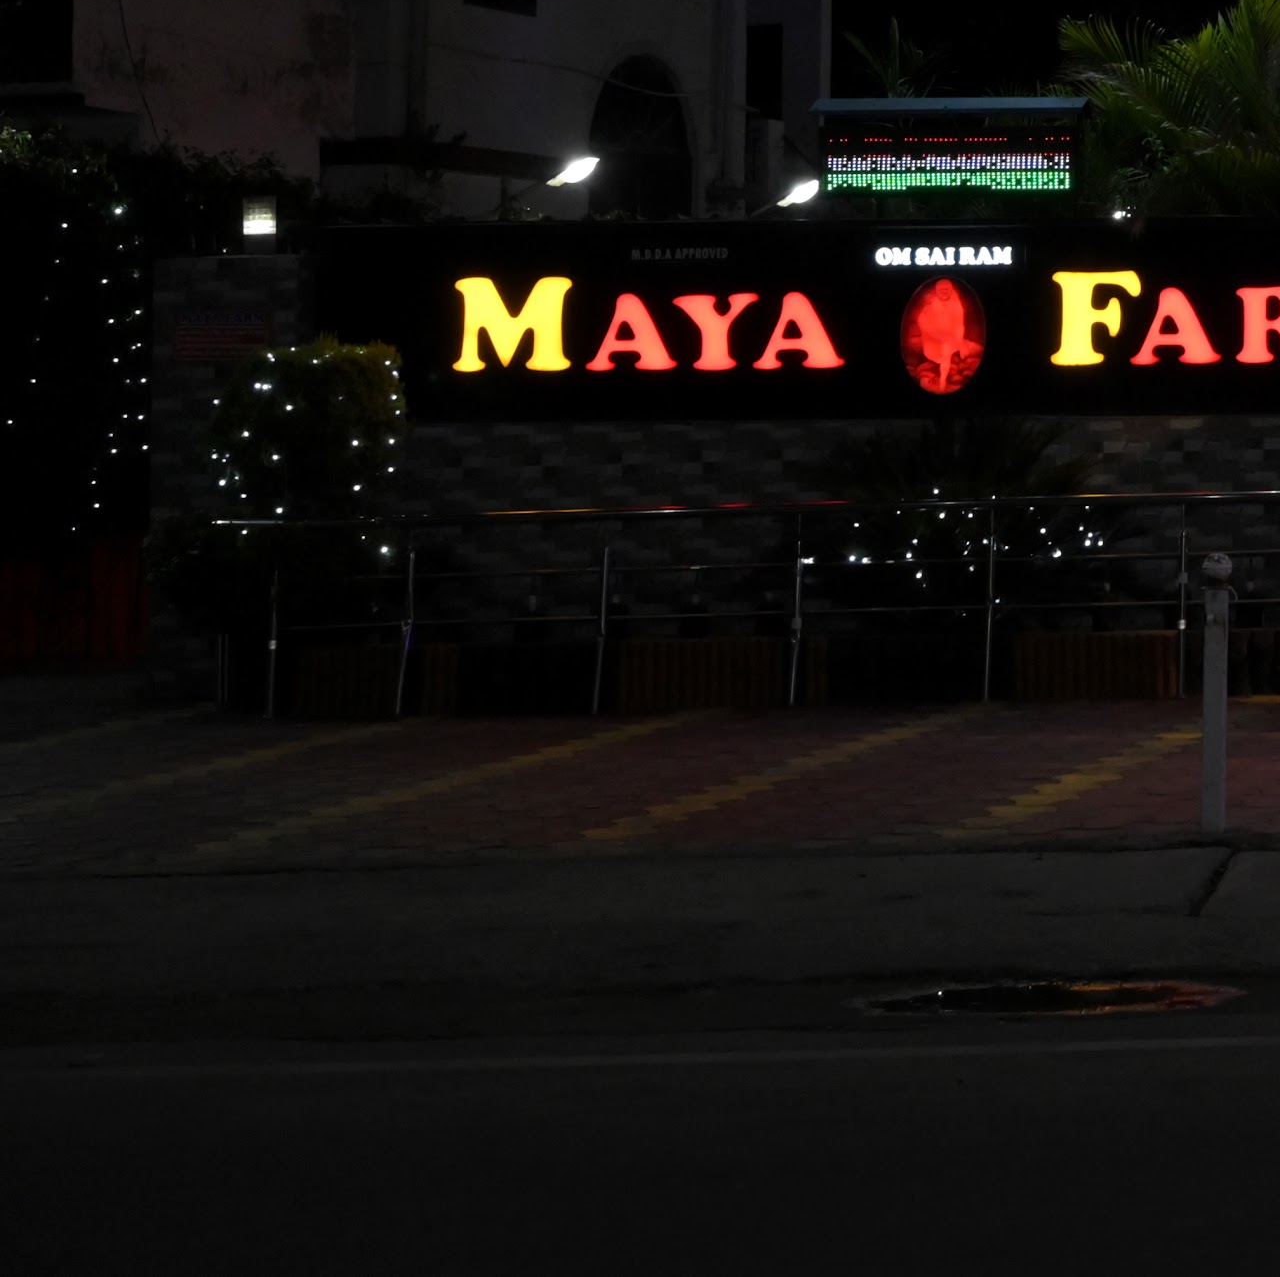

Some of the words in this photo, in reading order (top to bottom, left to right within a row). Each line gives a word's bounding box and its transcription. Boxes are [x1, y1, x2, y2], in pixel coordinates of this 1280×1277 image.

[674, 246, 729, 260] APPROVED
[874, 246, 912, 266] OM
[914, 246, 956, 266] SAI
[958, 245, 1013, 265] RAM
[452, 275, 845, 372] MAYA
